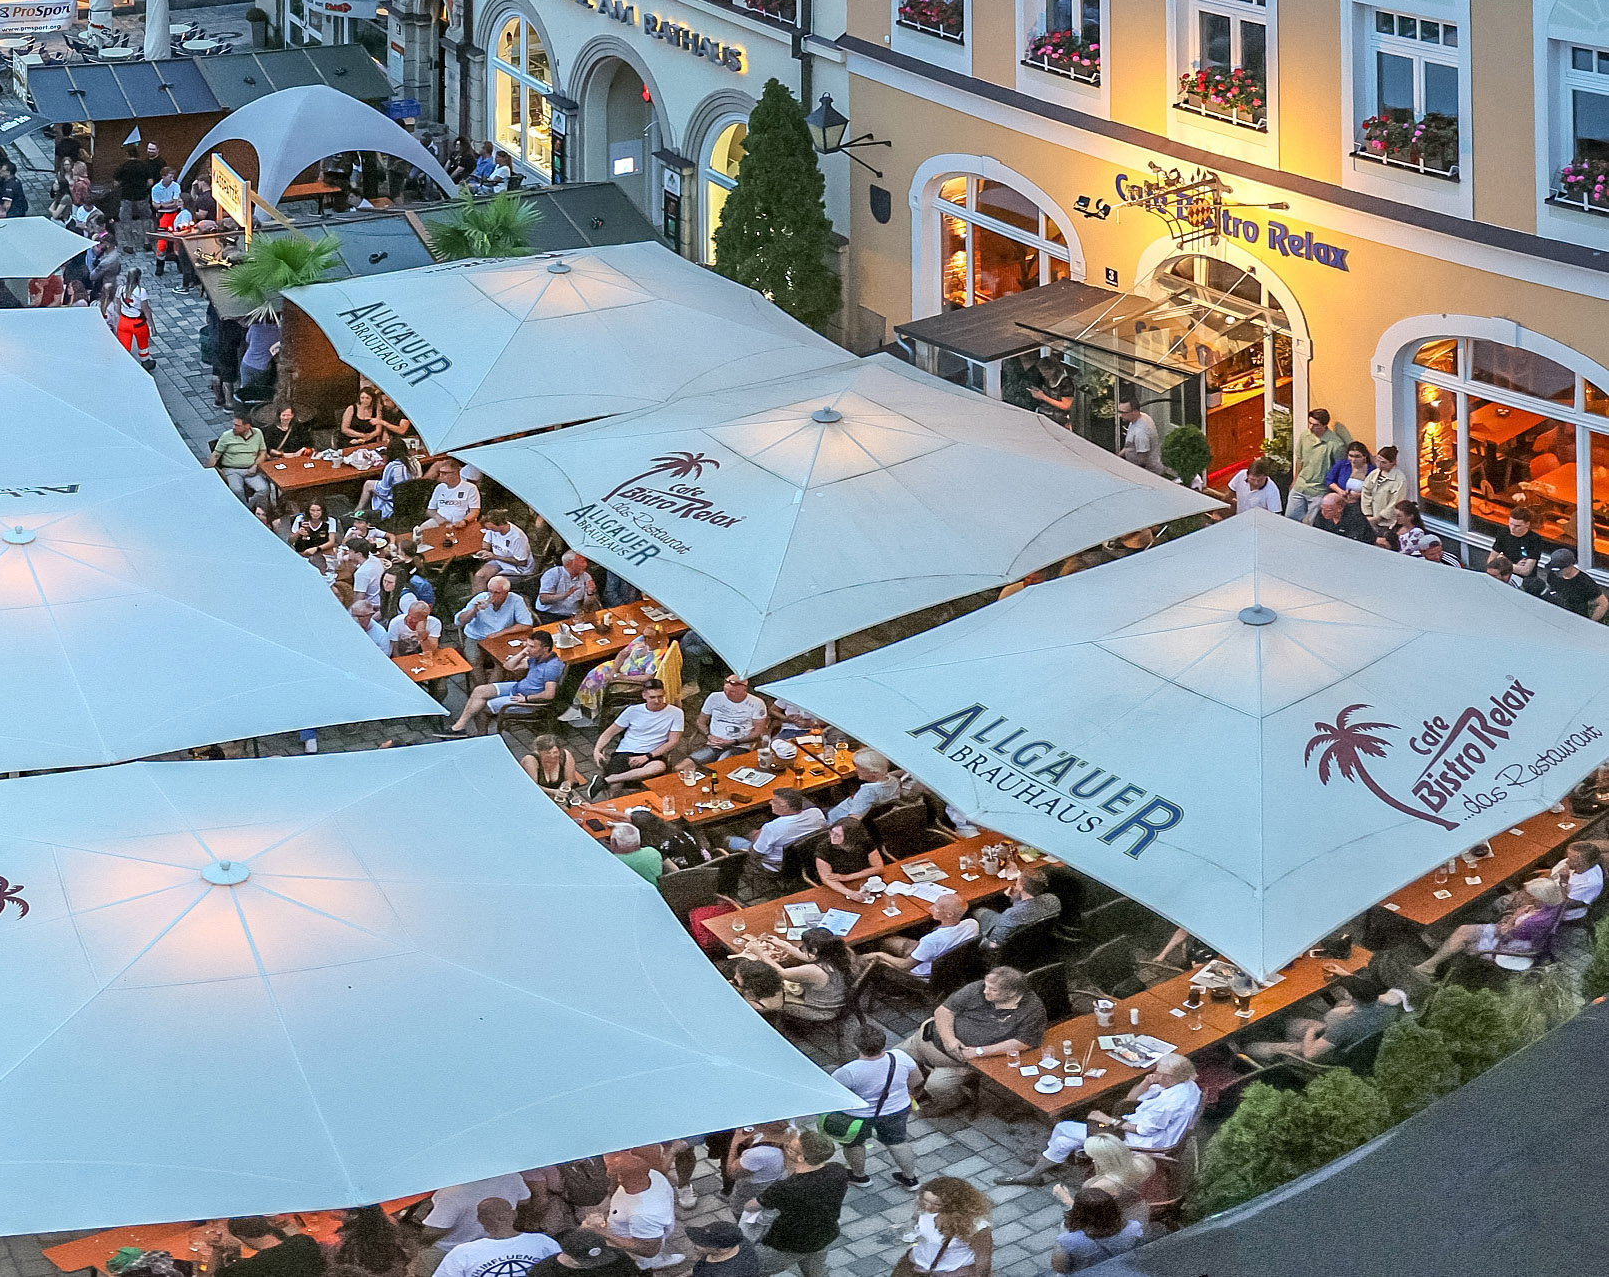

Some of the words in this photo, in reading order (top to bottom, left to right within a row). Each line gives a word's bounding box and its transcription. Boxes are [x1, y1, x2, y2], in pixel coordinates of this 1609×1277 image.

[643, 13, 743, 72] RATHAUS
[1268, 221, 1350, 272] Relax
[1108, 269, 1115, 280] 3
[336, 300, 454, 388] ALLGÄUER
[349, 321, 411, 373] BRAUHAUS
[617, 487, 673, 514] Bistro
[669, 497, 743, 529] Relax
[668, 483, 706, 498] Cafe
[564, 503, 661, 567] ALLGÄUER
[576, 519, 631, 557] BRAUHAUS
[632, 511, 692, 555] Restaurant
[1409, 715, 1450, 756] Cafe
[1411, 742, 1486, 814] Bistro
[1453, 678, 1535, 751] Relax
[1494, 724, 1603, 788] Restaurant
[904, 702, 1185, 861] ALLGÄUER
[948, 744, 1104, 834] BRAUHAUS
